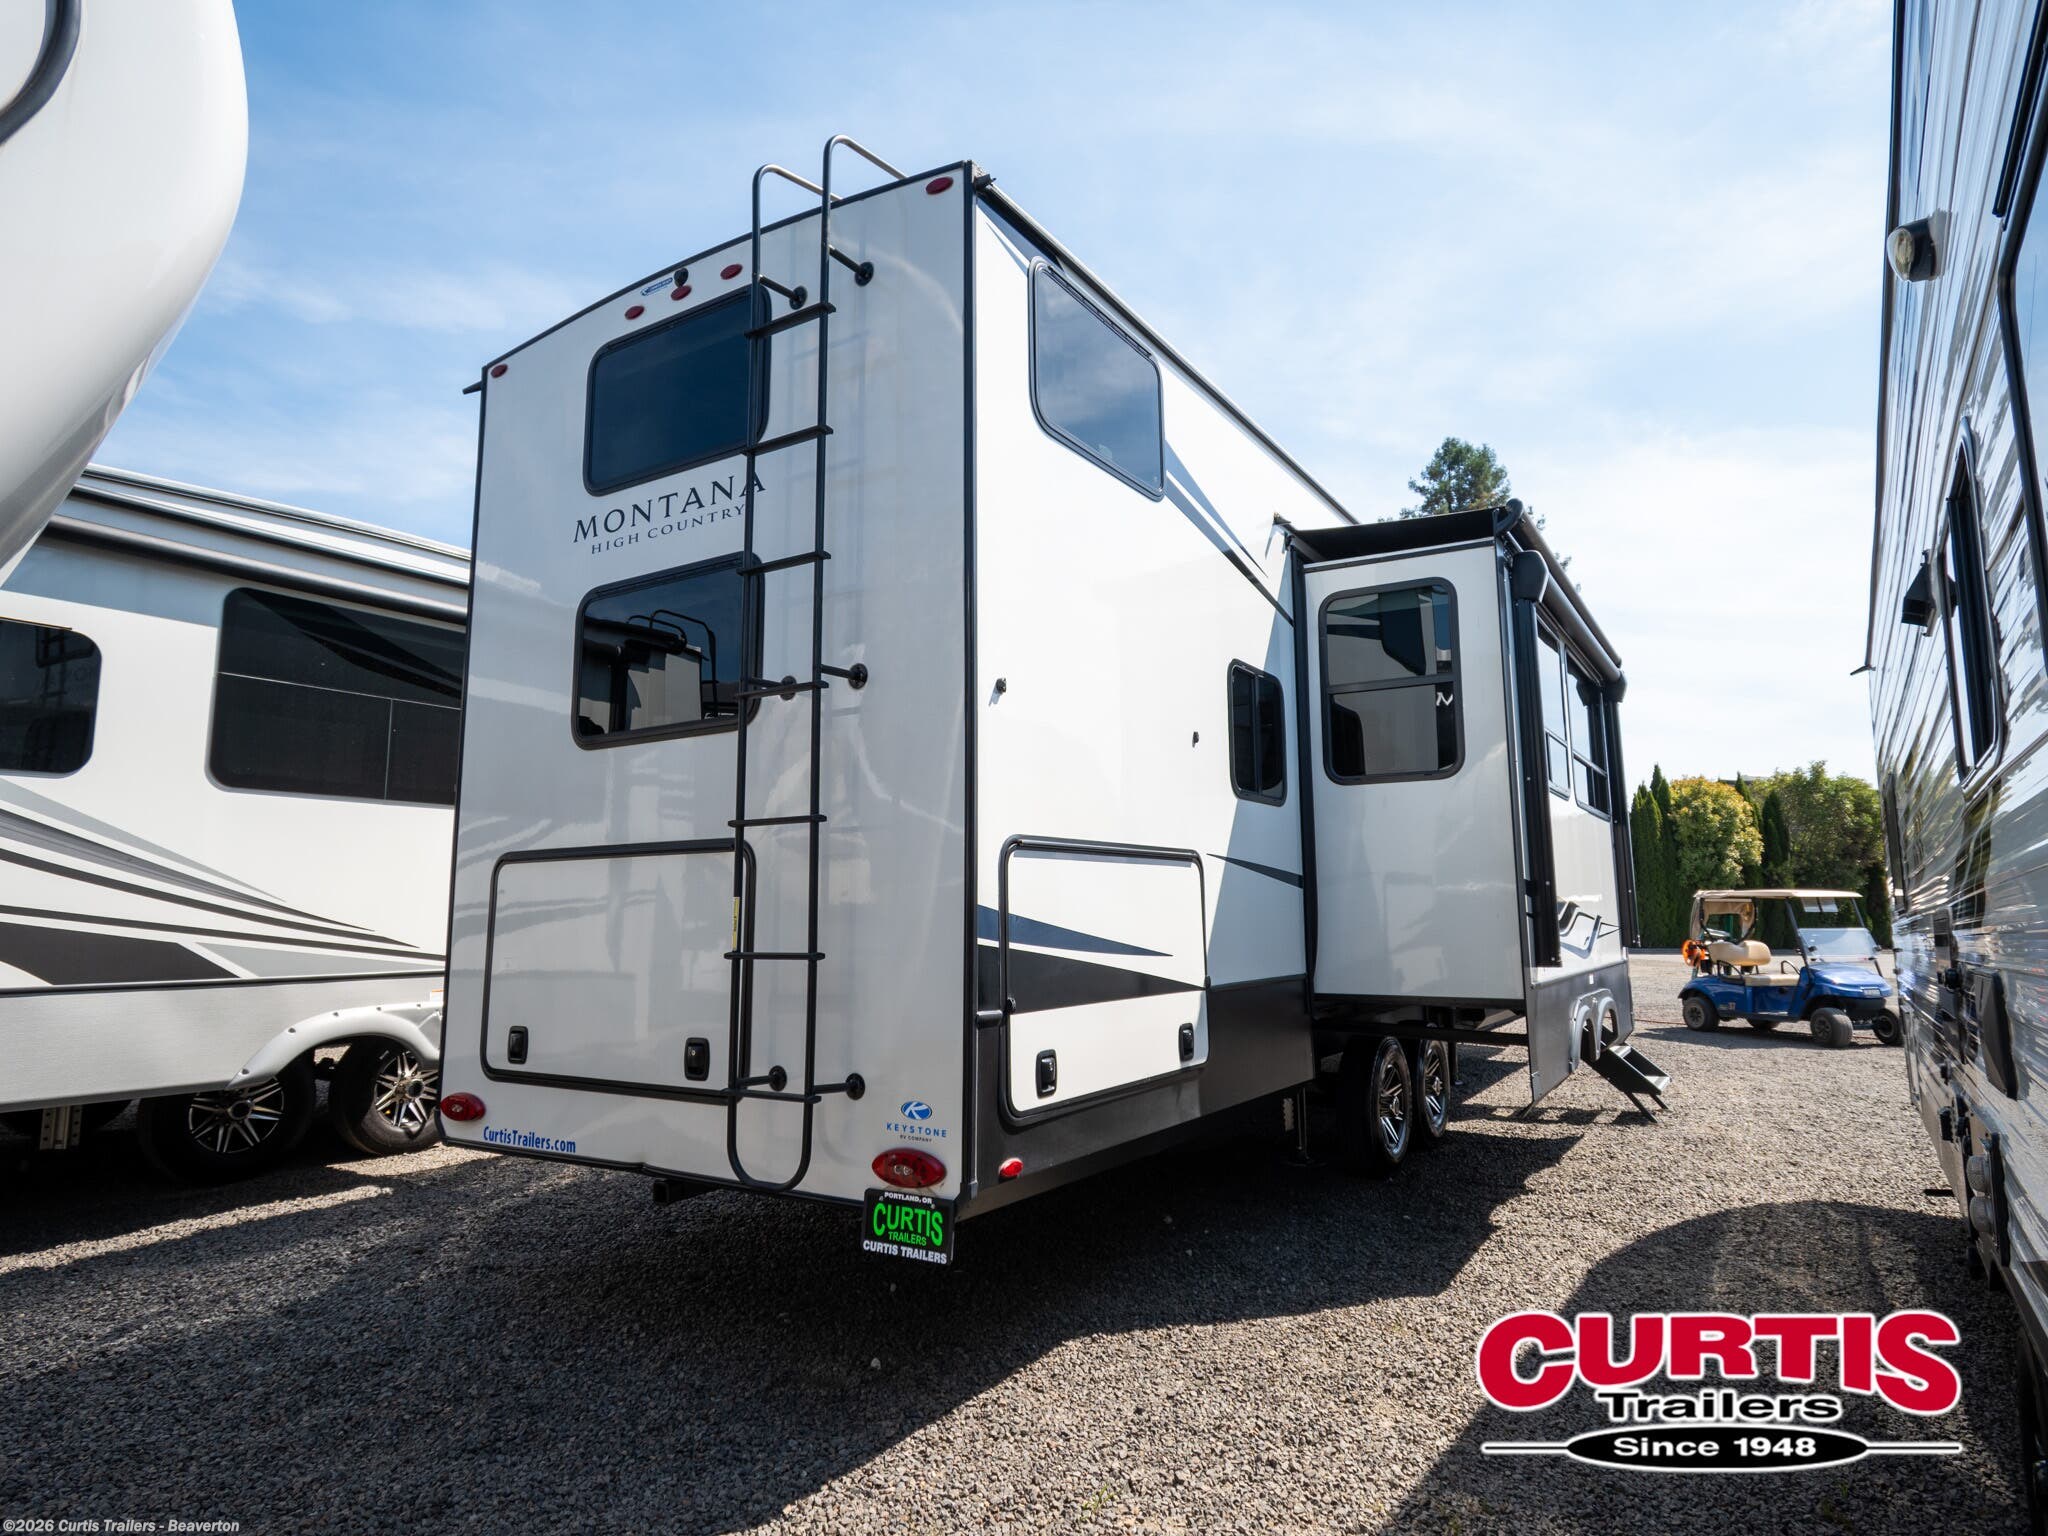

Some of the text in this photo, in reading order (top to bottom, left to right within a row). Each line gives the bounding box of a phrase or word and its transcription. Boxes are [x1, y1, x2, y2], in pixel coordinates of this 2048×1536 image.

[573, 471, 766, 543] MONTANA
[591, 504, 745, 554] HIGH COUNTRY
[483, 1126, 576, 1153] CurtisTrailers.com
[886, 1122, 947, 1138] KEYSTONE
[884, 1191, 922, 1202] PORTLAND,
[873, 1202, 943, 1246] CURTIS
[888, 1231, 927, 1246] TRAILERS
[863, 1240, 947, 1265] CURTIS TRAILERS
